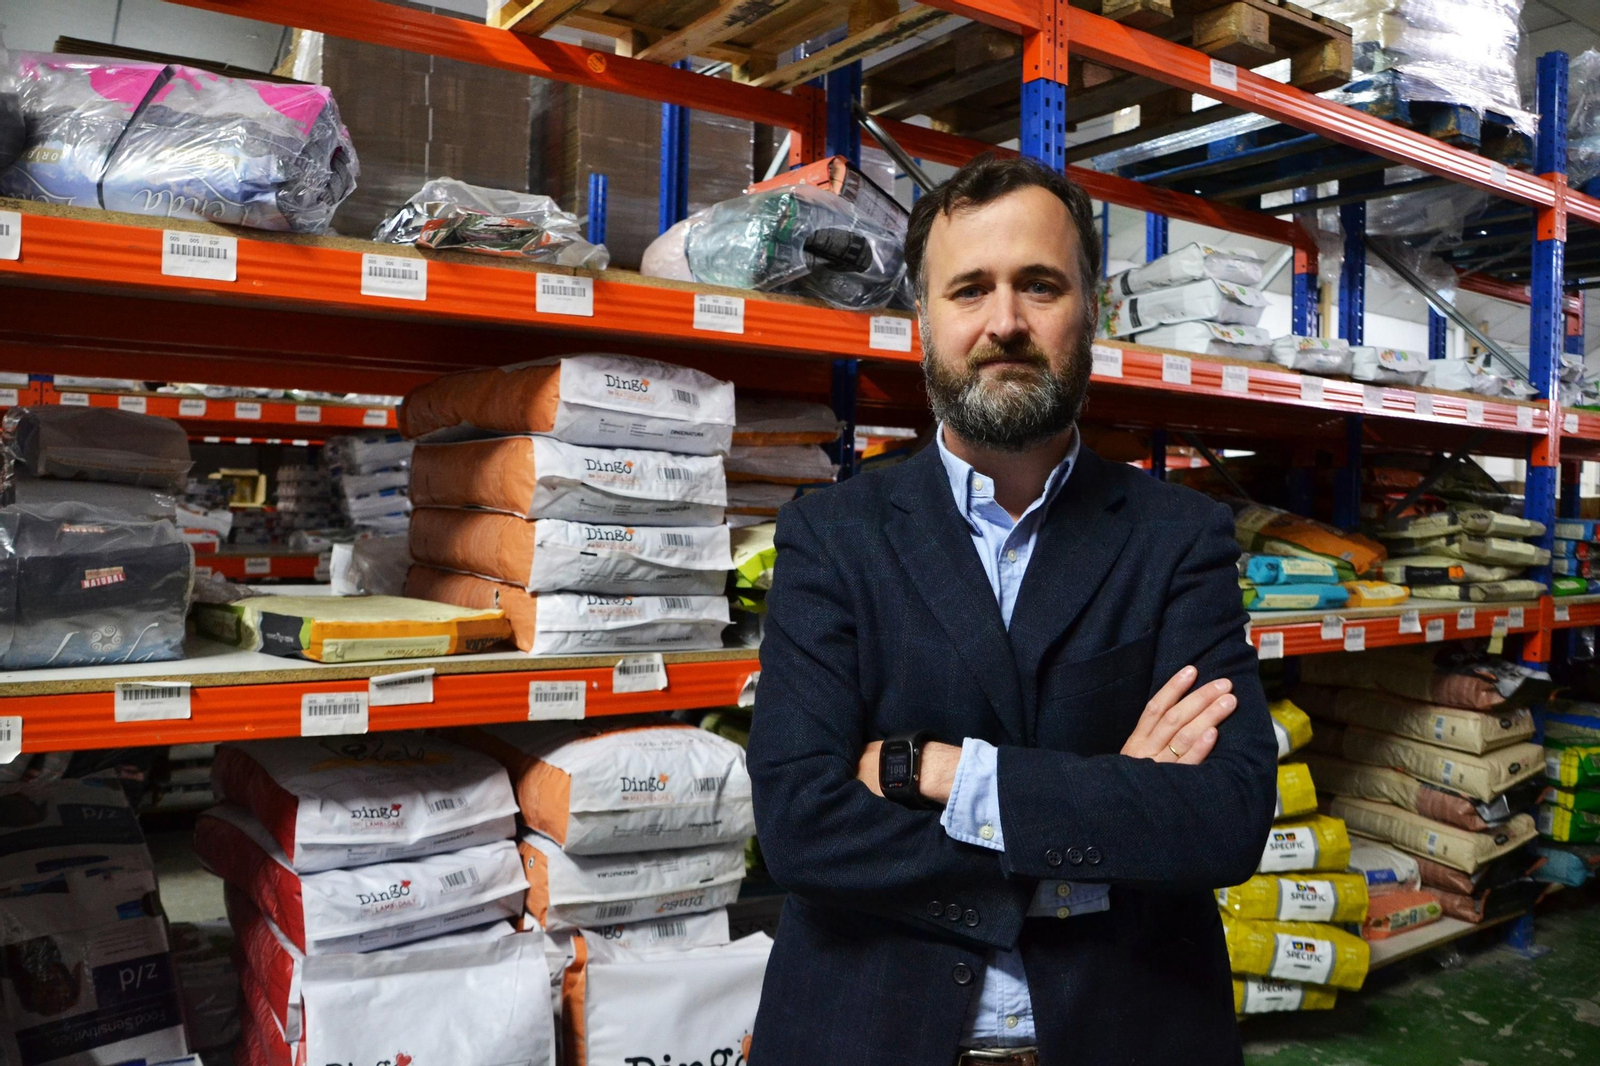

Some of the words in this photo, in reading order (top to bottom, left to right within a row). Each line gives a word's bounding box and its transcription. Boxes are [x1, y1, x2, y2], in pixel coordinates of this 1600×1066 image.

[604, 374, 648, 393] Dingo
[584, 459, 632, 474] Dingo
[585, 527, 633, 541] Dingo
[83, 573, 125, 589] NATURAL
[620, 777, 666, 792] Dingo
[351, 806, 400, 819] Dingo
[1270, 841, 1305, 850] SPECIFIC
[356, 883, 410, 905] Dingo
[1290, 892, 1327, 902] SPECIFIC
[659, 894, 706, 912] Dingo
[1286, 951, 1323, 963] SPECIFIC
[119, 962, 158, 991] z/d
[1257, 985, 1293, 993] SPECIFIC
[137, 1009, 167, 1026] Food
[52, 1017, 136, 1047] Sensitivities
